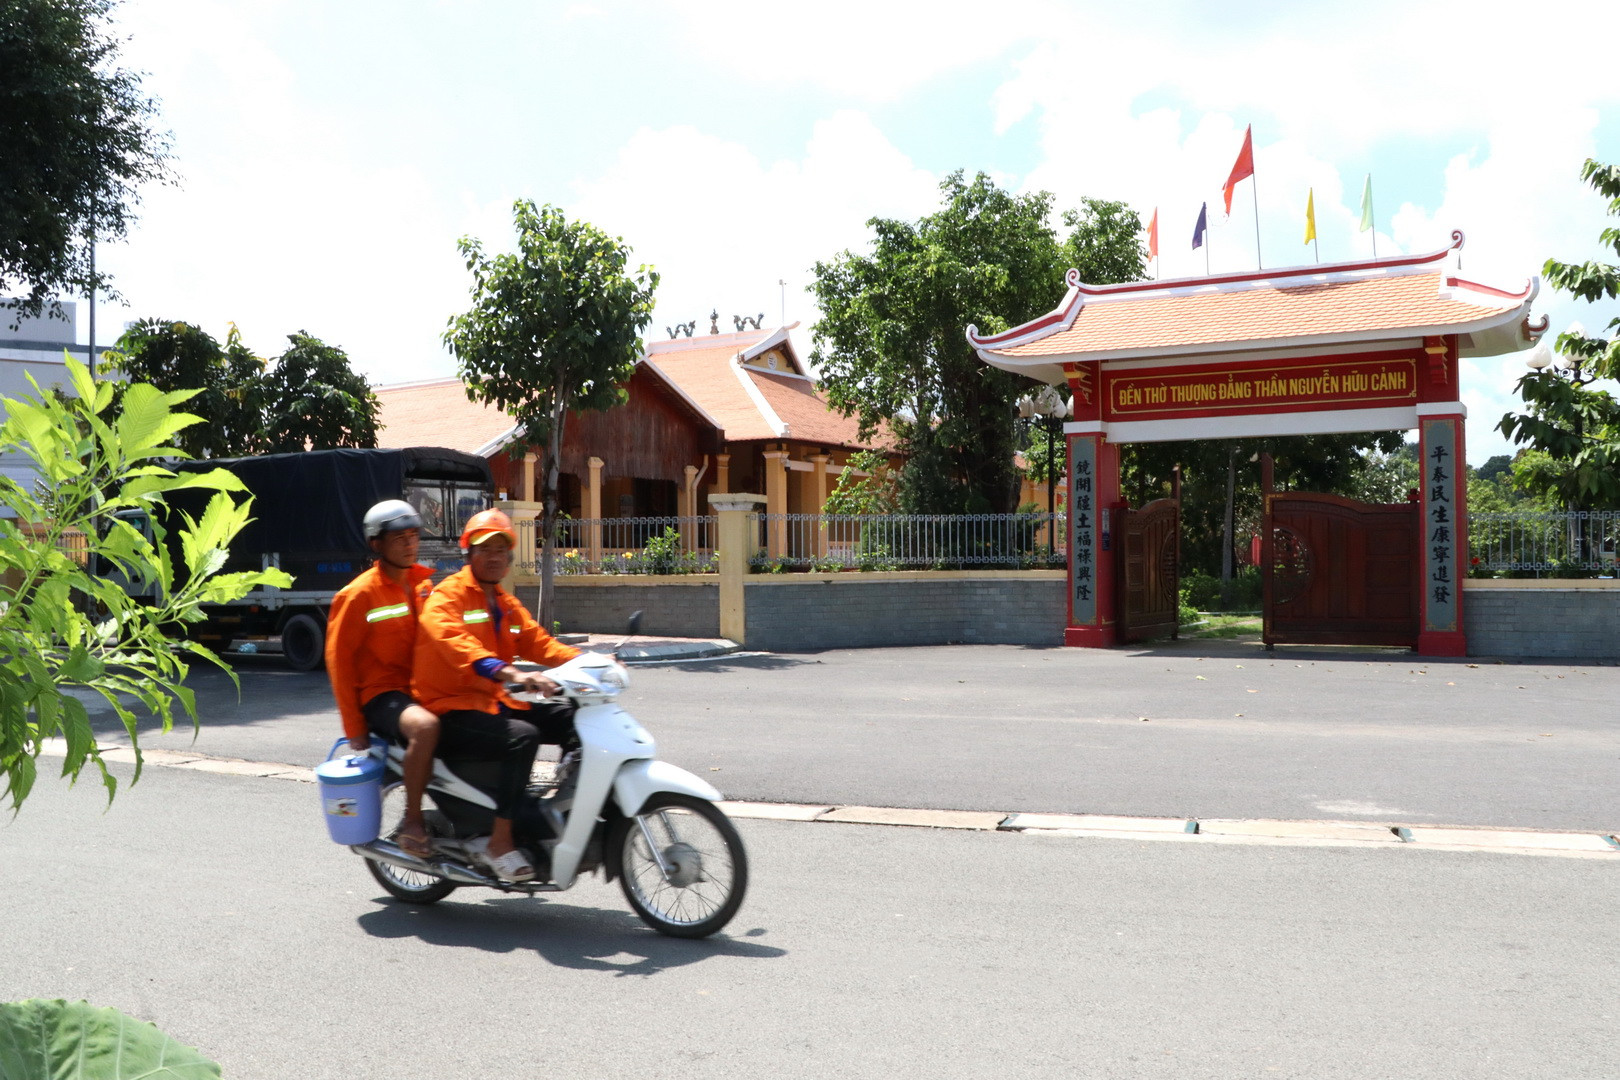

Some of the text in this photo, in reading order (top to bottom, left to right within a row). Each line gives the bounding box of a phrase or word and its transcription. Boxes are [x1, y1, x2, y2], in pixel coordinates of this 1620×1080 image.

[1119, 366, 1407, 406] ĐỀN THỜ THƯỢNG ĐẲNG THẦN NGUYỄN HỮU CẢNH
